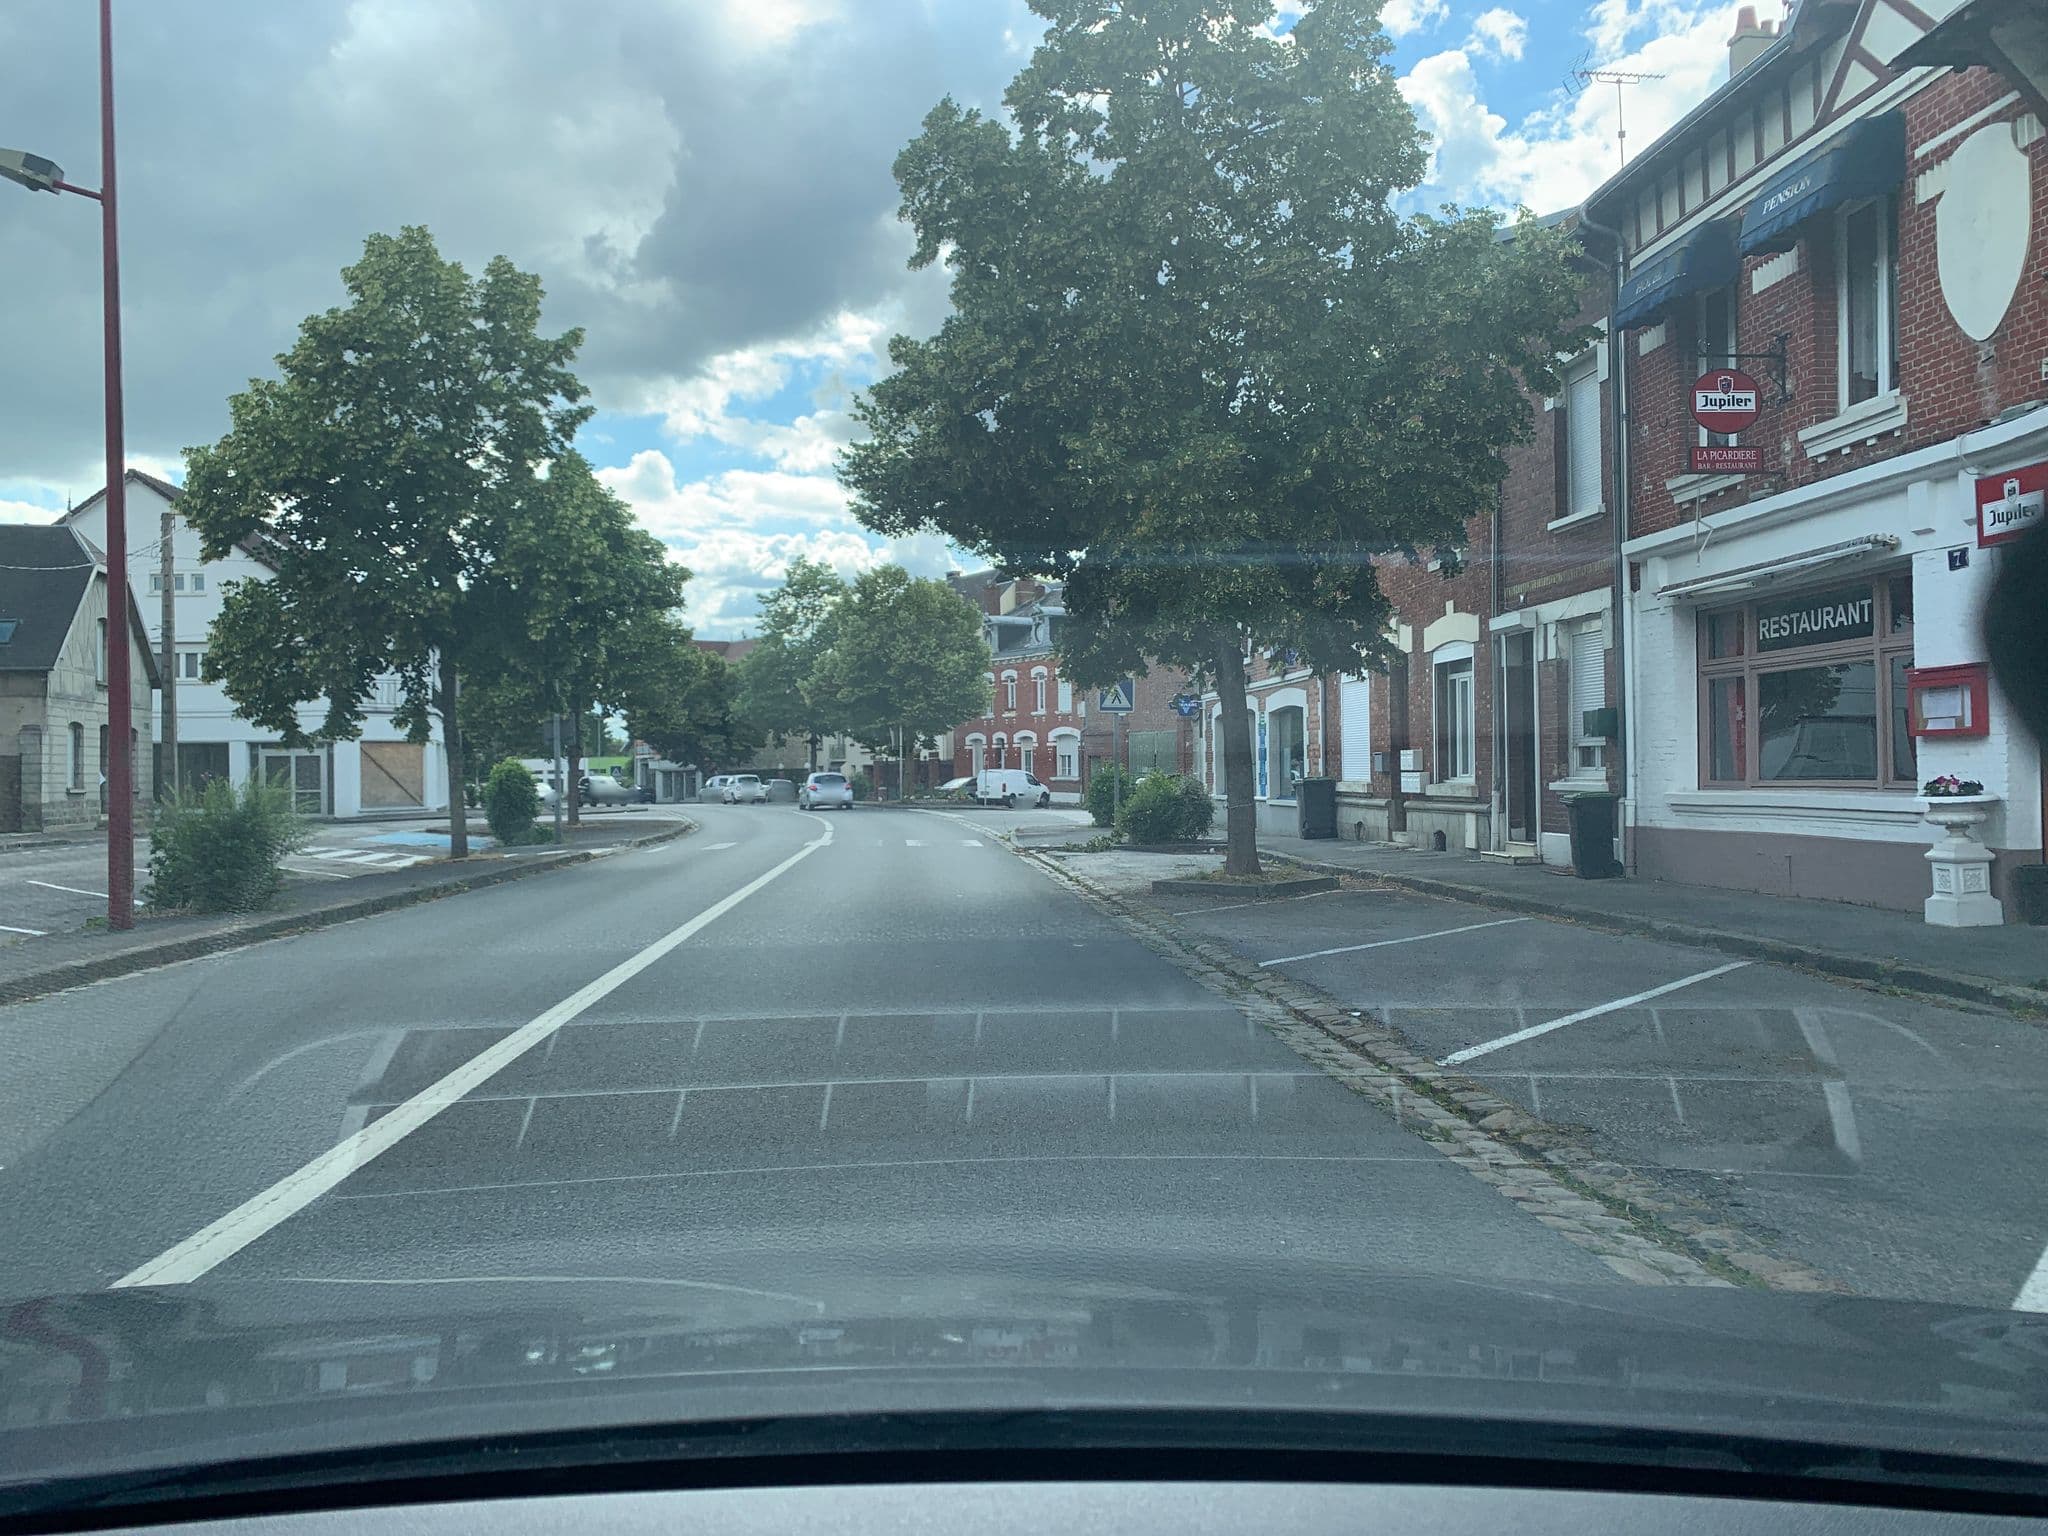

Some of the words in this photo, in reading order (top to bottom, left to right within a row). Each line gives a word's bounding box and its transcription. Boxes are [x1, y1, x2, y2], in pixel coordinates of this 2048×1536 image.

[1762, 176, 1811, 215] PENSION
[1701, 395, 1752, 409] Jupiler
[1697, 450, 1708, 461] LA
[1697, 462, 1710, 470] BAR
[1715, 462, 1757, 470] RESTAURANT
[1760, 599, 1872, 640] RESTAURANT
